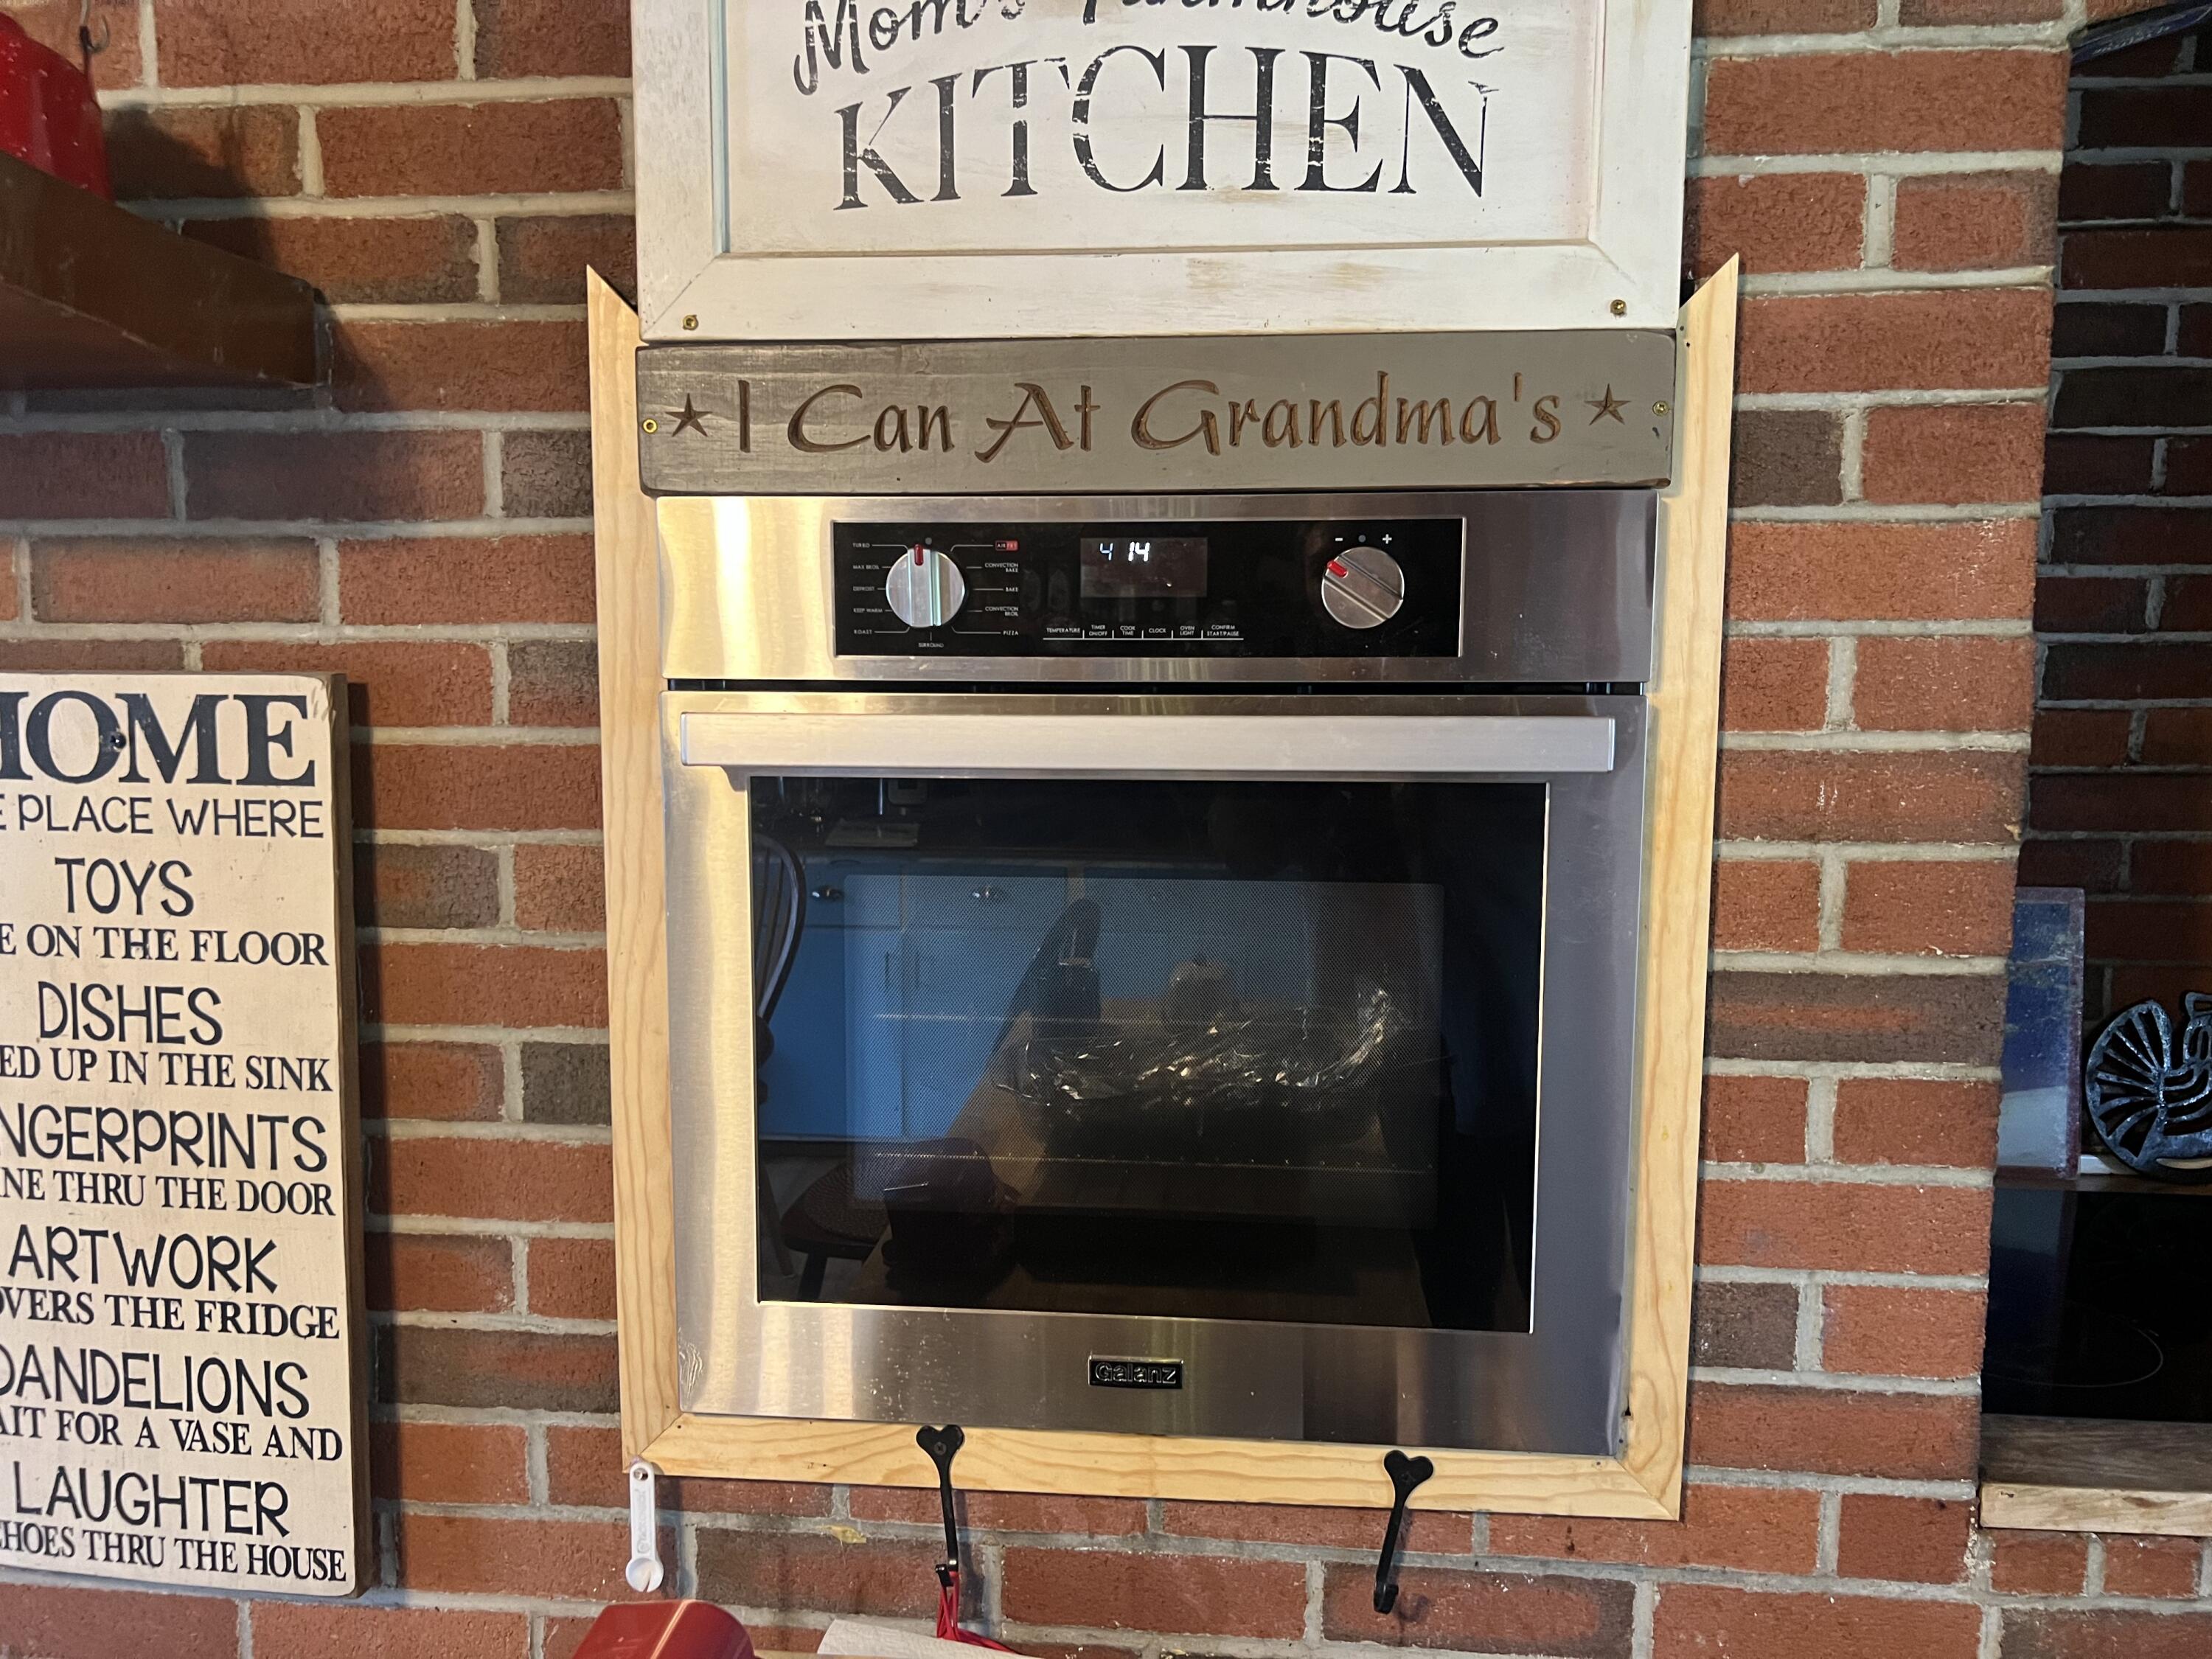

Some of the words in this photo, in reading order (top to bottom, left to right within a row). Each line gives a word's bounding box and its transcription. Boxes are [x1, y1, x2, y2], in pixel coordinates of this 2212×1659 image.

[793, 0, 1026, 95] Mom
[833, 44, 1500, 212] KITCHEN
[737, 378, 751, 455] I
[786, 383, 956, 455] Can
[975, 381, 1102, 465] At
[1131, 370, 1562, 458] Grandma's
[18, 794, 154, 835] PLACE
[166, 799, 324, 838] WHERE
[55, 857, 195, 917] TOYS
[27, 924, 82, 958] ON
[94, 927, 179, 961] THE
[190, 929, 330, 967] FLOOR
[38, 981, 223, 1046] DISHES
[49, 1047, 98, 1083] UP
[108, 1050, 148, 1085] IN
[159, 1053, 237, 1089] THE
[245, 1056, 335, 1093] SINK
[53, 1169, 146, 1208] THRU
[156, 1175, 228, 1211] THE
[236, 1180, 337, 1217] DOOR
[7, 1223, 279, 1295] ARTWORK
[0, 1286, 95, 1326] VERS
[105, 1295, 185, 1331] THE
[195, 1300, 341, 1340] FRIDGE
[1094, 1362, 1177, 1385] Galanz
[56, 1410, 123, 1447] FOR
[135, 1416, 161, 1450] A
[168, 1419, 253, 1456] VASE
[262, 1425, 343, 1462] AND
[13, 1461, 291, 1539] LAUGHTER
[0, 1520, 76, 1559] HOES
[82, 1529, 167, 1568] THRU
[173, 1537, 240, 1573] THE
[245, 1543, 348, 1583] HOUSE
